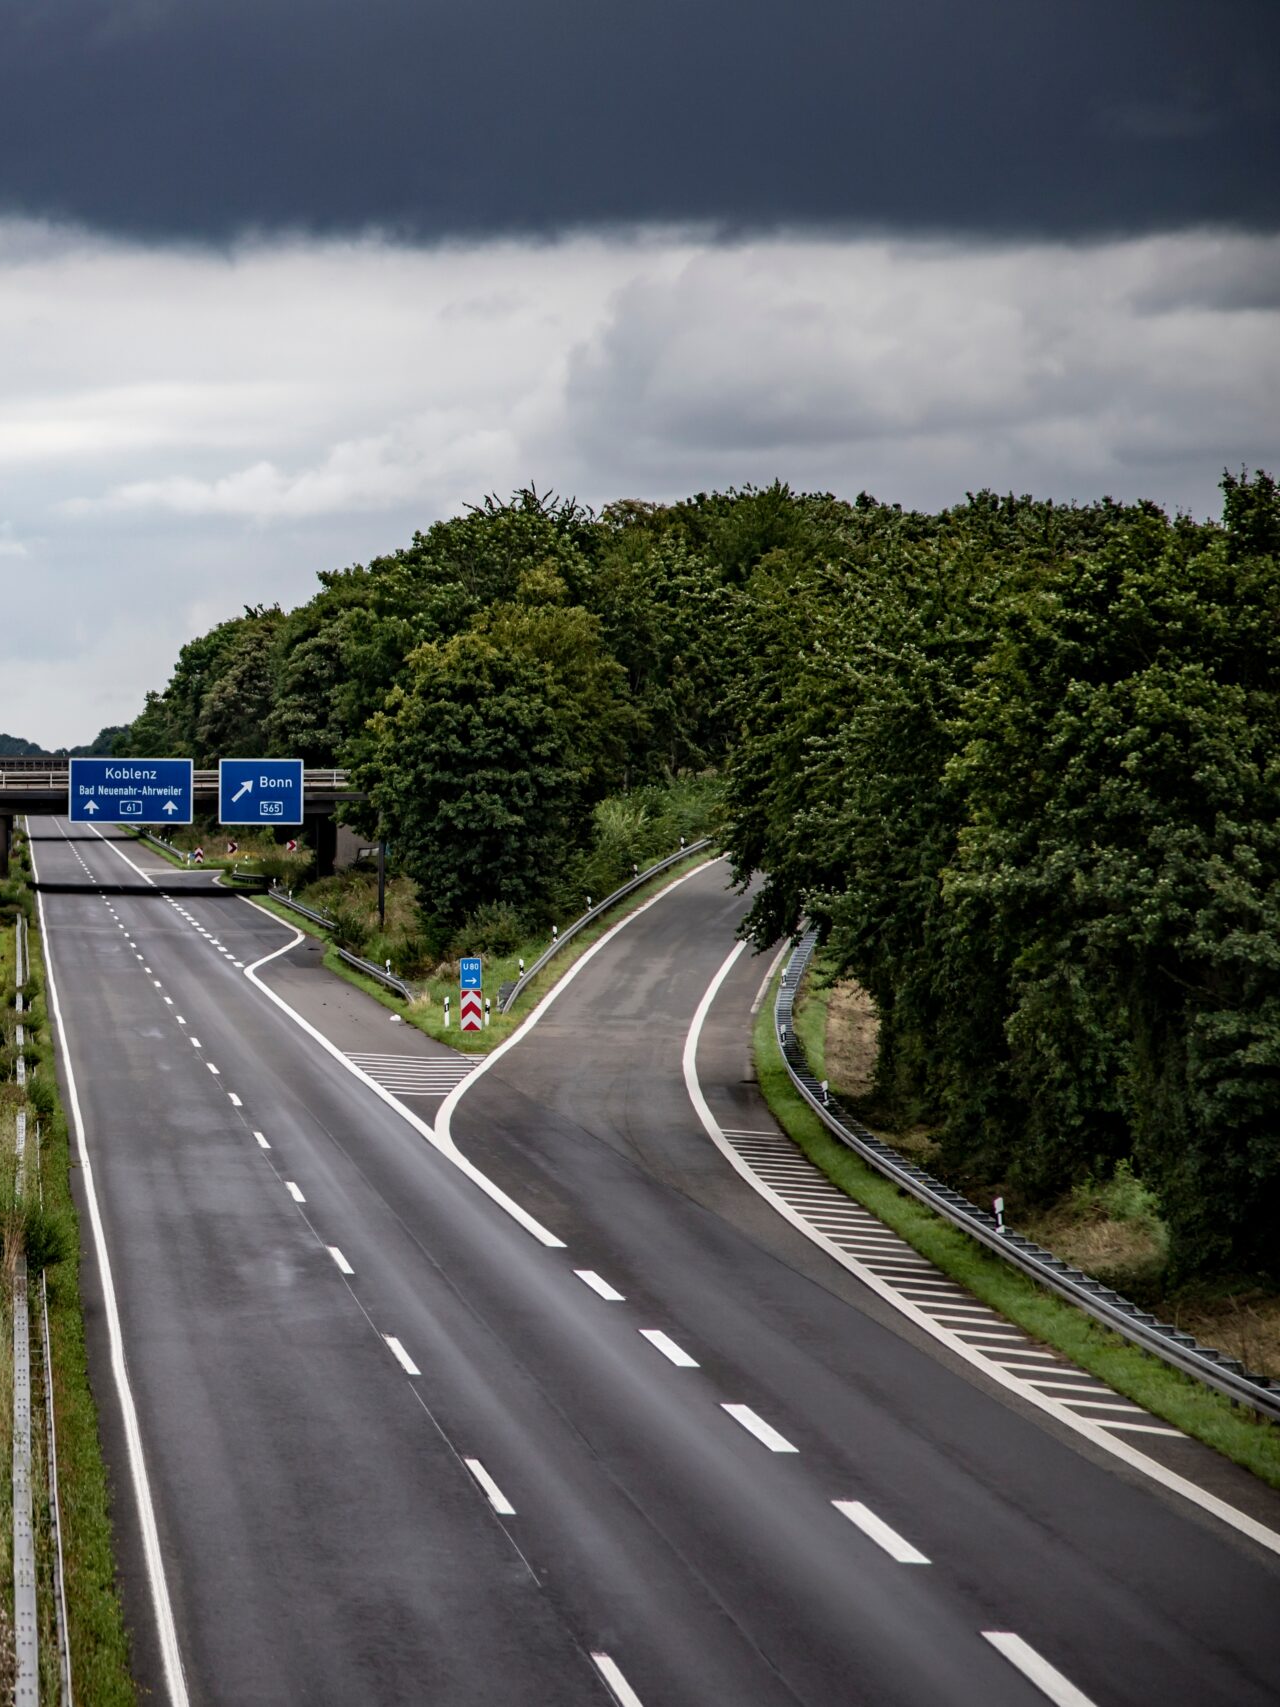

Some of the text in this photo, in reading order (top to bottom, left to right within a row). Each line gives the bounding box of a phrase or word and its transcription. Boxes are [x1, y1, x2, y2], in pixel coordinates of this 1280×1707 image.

[105, 767, 157, 779] Koblenz
[259, 776, 293, 788] Bonn
[79, 785, 182, 795] Bad Neuenahr-Ahrweiler
[126, 803, 136, 812] 61
[263, 804, 280, 813] 565
